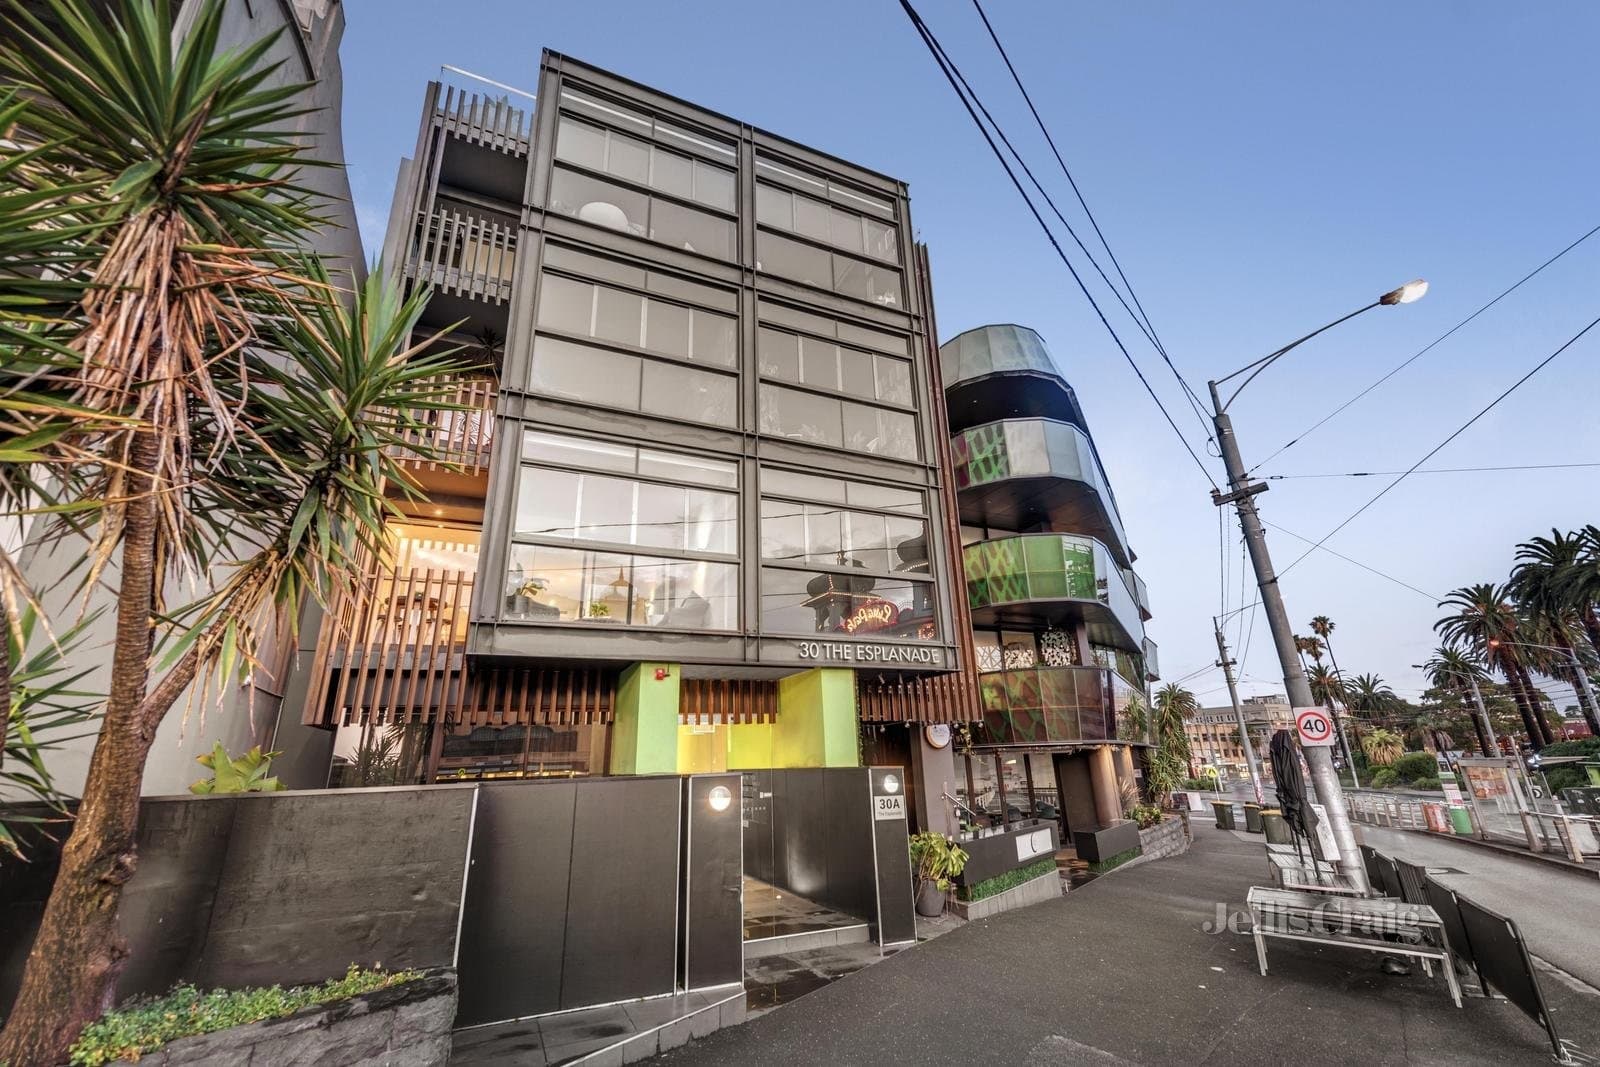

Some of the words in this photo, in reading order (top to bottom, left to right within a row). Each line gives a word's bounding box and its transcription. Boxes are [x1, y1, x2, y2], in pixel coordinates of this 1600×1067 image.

[800, 642, 819, 658] 30
[824, 643, 851, 660] THE
[856, 645, 940, 663] ESPLANADE
[1303, 719, 1326, 732] 40
[880, 798, 900, 809] 30A
